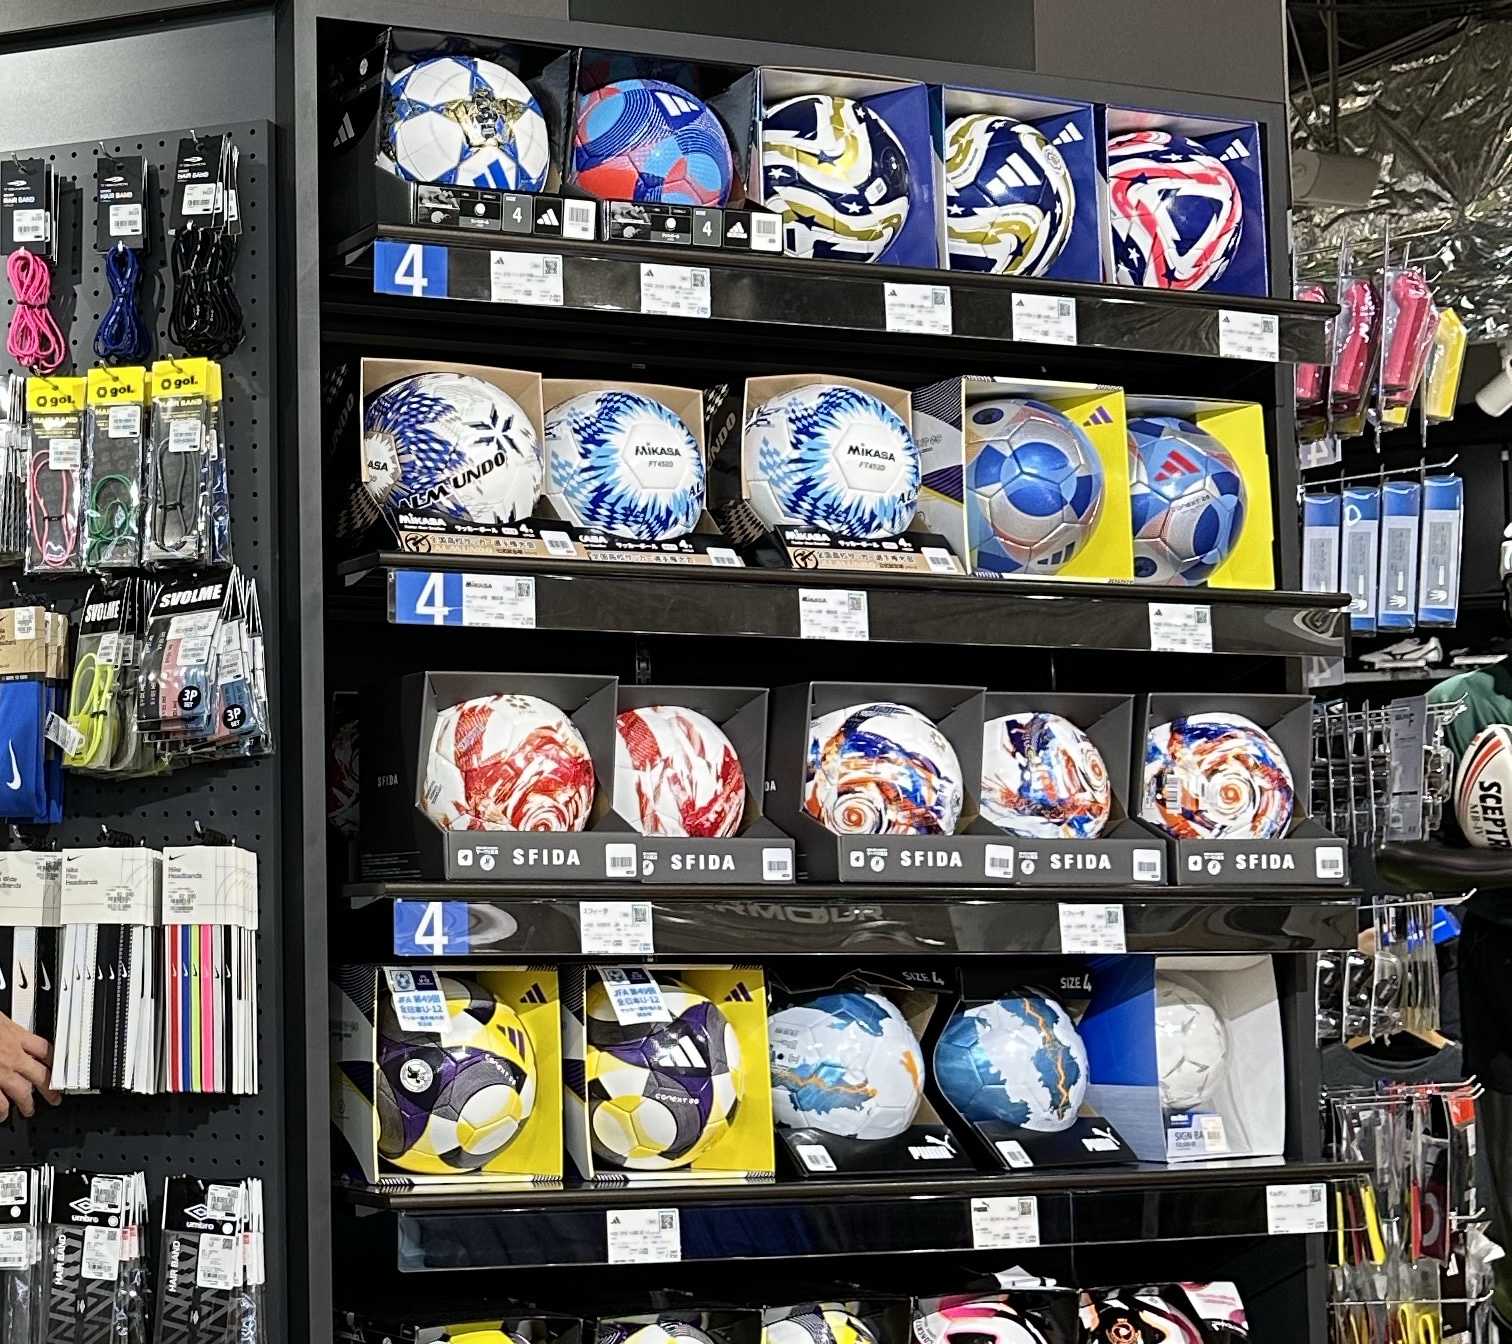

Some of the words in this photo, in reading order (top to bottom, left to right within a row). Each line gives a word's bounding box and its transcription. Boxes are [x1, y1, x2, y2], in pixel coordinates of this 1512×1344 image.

[513, 207, 522, 223] 4
[702, 221, 712, 236] 4
[394, 243, 428, 296] 4
[159, 584, 223, 607] SVOLME
[415, 573, 449, 625] 4
[85, 600, 120, 623] SVOLME
[184, 690, 198, 701] 3P
[227, 707, 241, 720] 3P
[513, 848, 580, 865] SFIDA
[671, 853, 736, 871] SFIDA
[900, 850, 962, 867] SFIDA
[1050, 854, 1111, 870] SFIDA
[1235, 854, 1295, 870] SFIDA
[414, 901, 448, 955] 4
[902, 971, 931, 982] SIZE
[932, 972, 944, 985] 4
[1060, 977, 1081, 989] SIZE
[1083, 974, 1092, 992] 4
[71, 1214, 99, 1224] umbro
[186, 1221, 215, 1231] umbro
[57, 1234, 67, 1259] BAND
[170, 1240, 181, 1266] BAND
[55, 1260, 65, 1286] HAIR
[169, 1267, 179, 1292] HAIR
